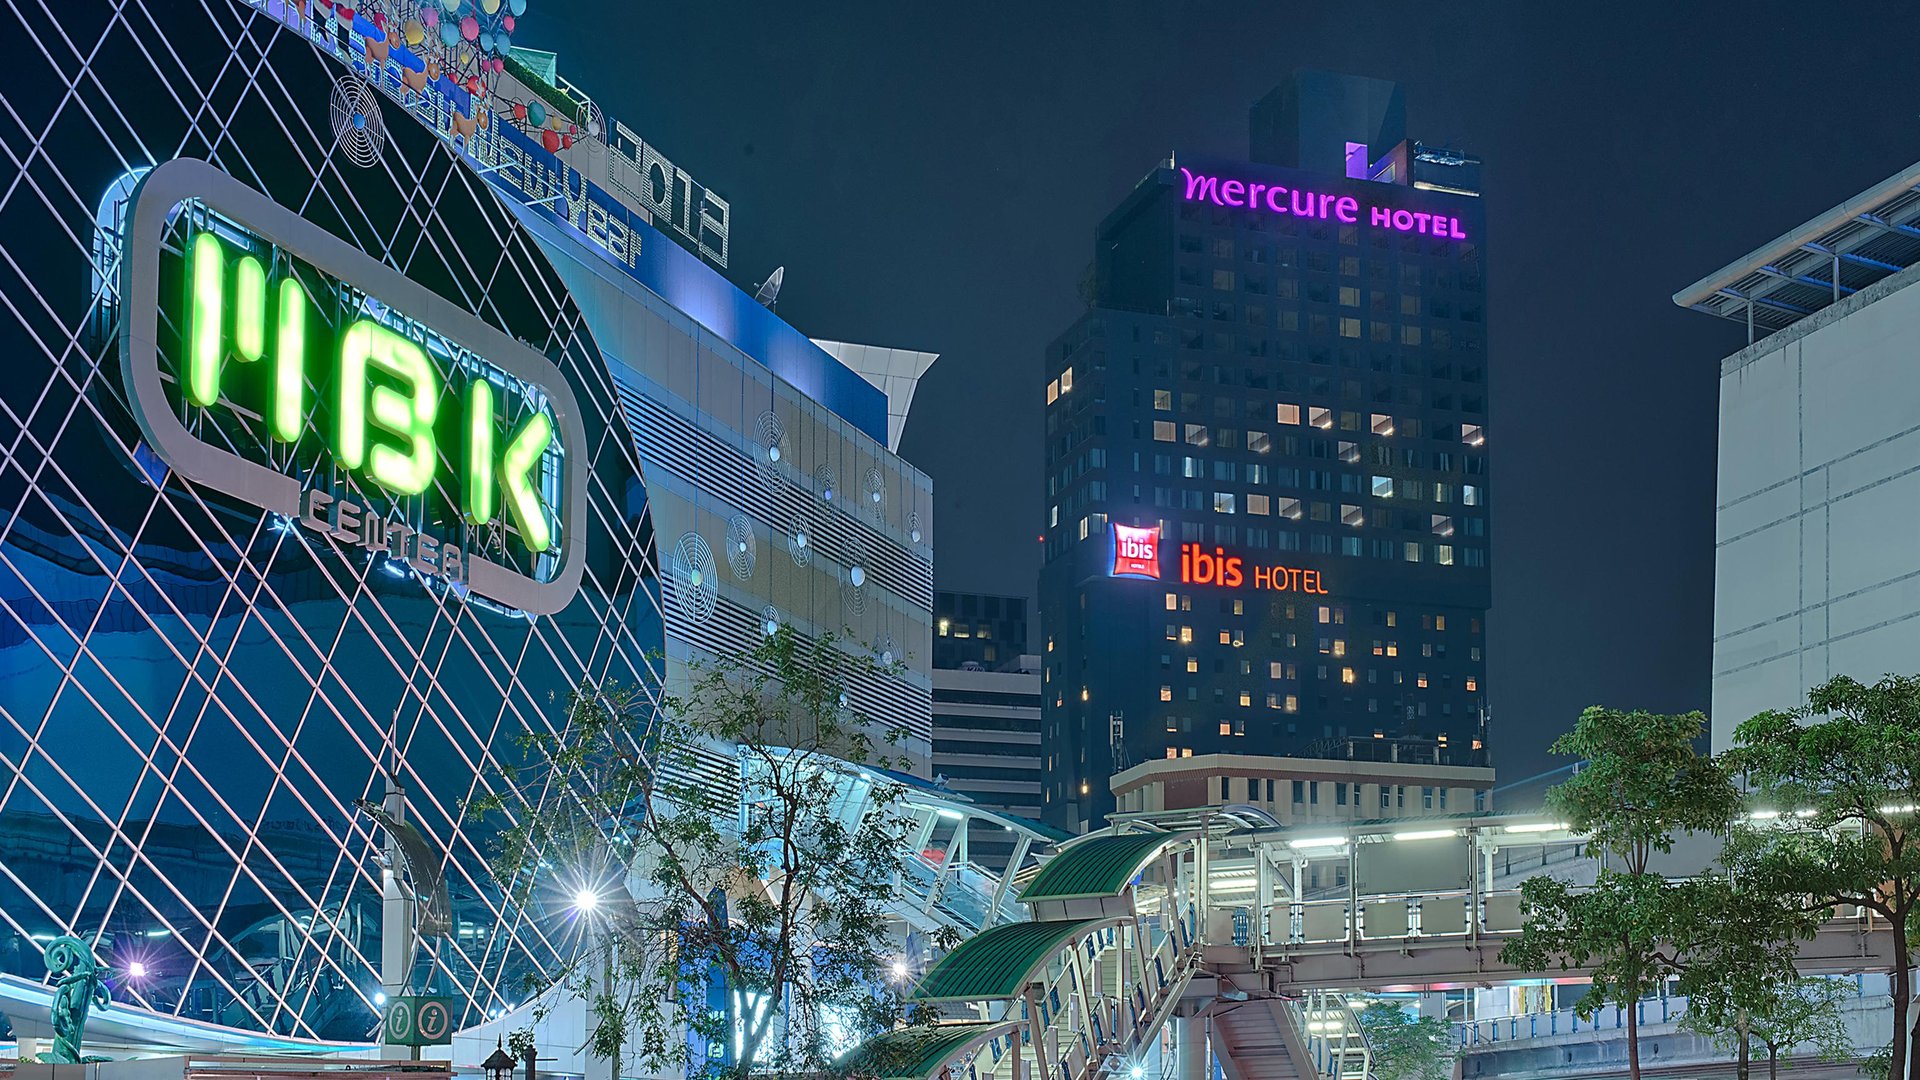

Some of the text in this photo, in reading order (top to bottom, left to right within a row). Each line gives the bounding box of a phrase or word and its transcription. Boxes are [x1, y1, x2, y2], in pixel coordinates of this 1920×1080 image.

[1371, 206, 1466, 239] HOTEL
[185, 232, 552, 554] MBK
[303, 489, 463, 581] CENTER
[1121, 538, 1153, 560] ibis
[1181, 544, 1328, 594] ibis HOTEL
